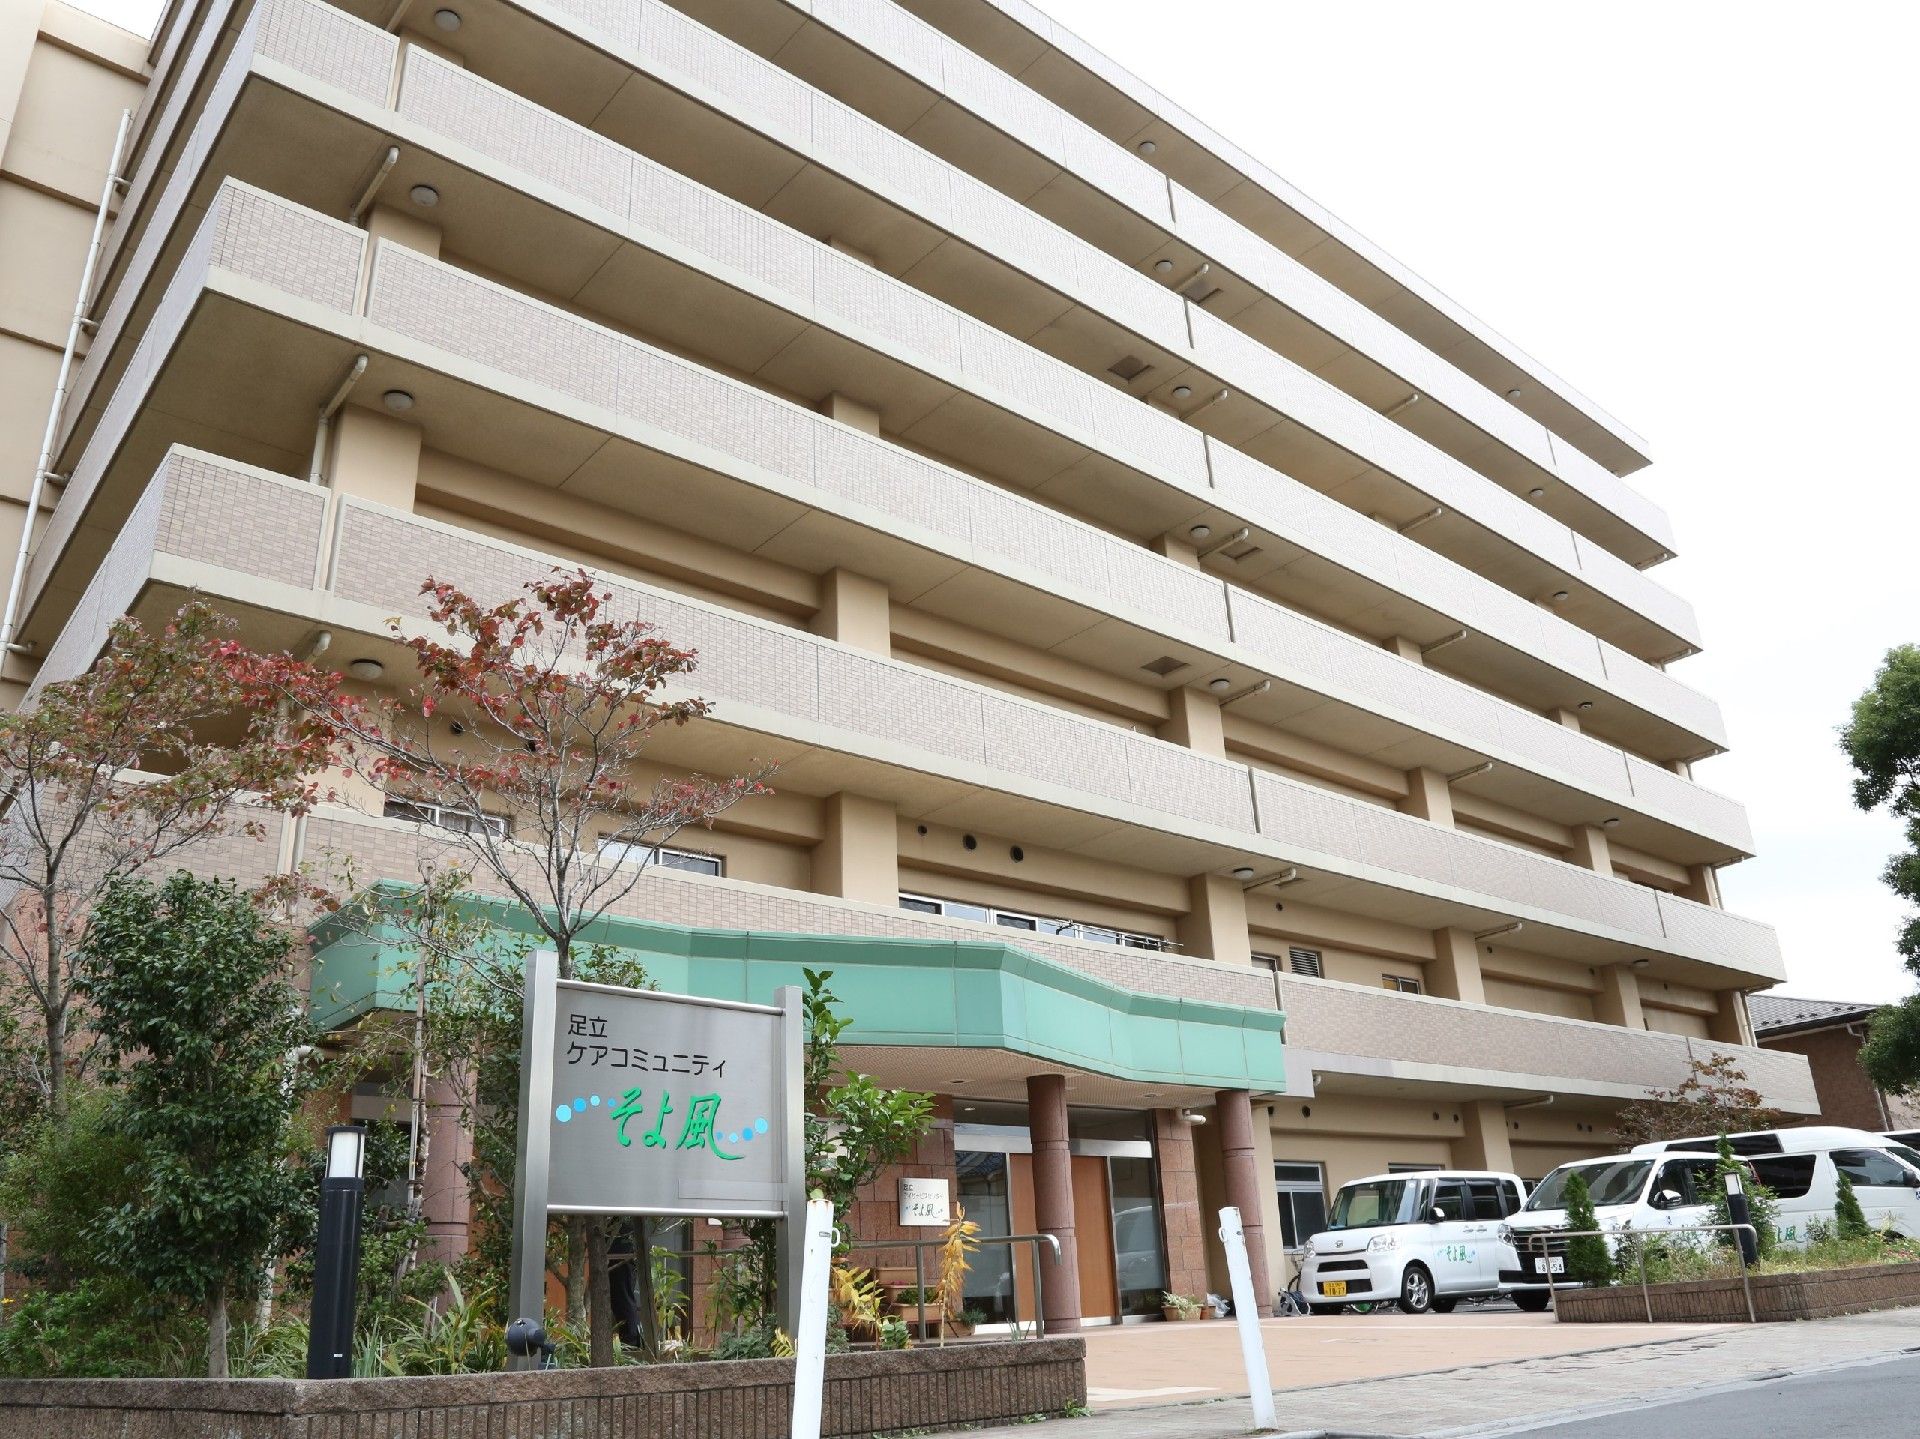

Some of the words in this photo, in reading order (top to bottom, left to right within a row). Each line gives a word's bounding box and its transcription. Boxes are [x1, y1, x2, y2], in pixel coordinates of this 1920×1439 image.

[567, 1013, 608, 1038] 足立
[566, 1041, 726, 1078] ケアコミュニティ
[610, 1087, 746, 1161] そよ風
[1446, 1245, 1473, 1263] そよ風
